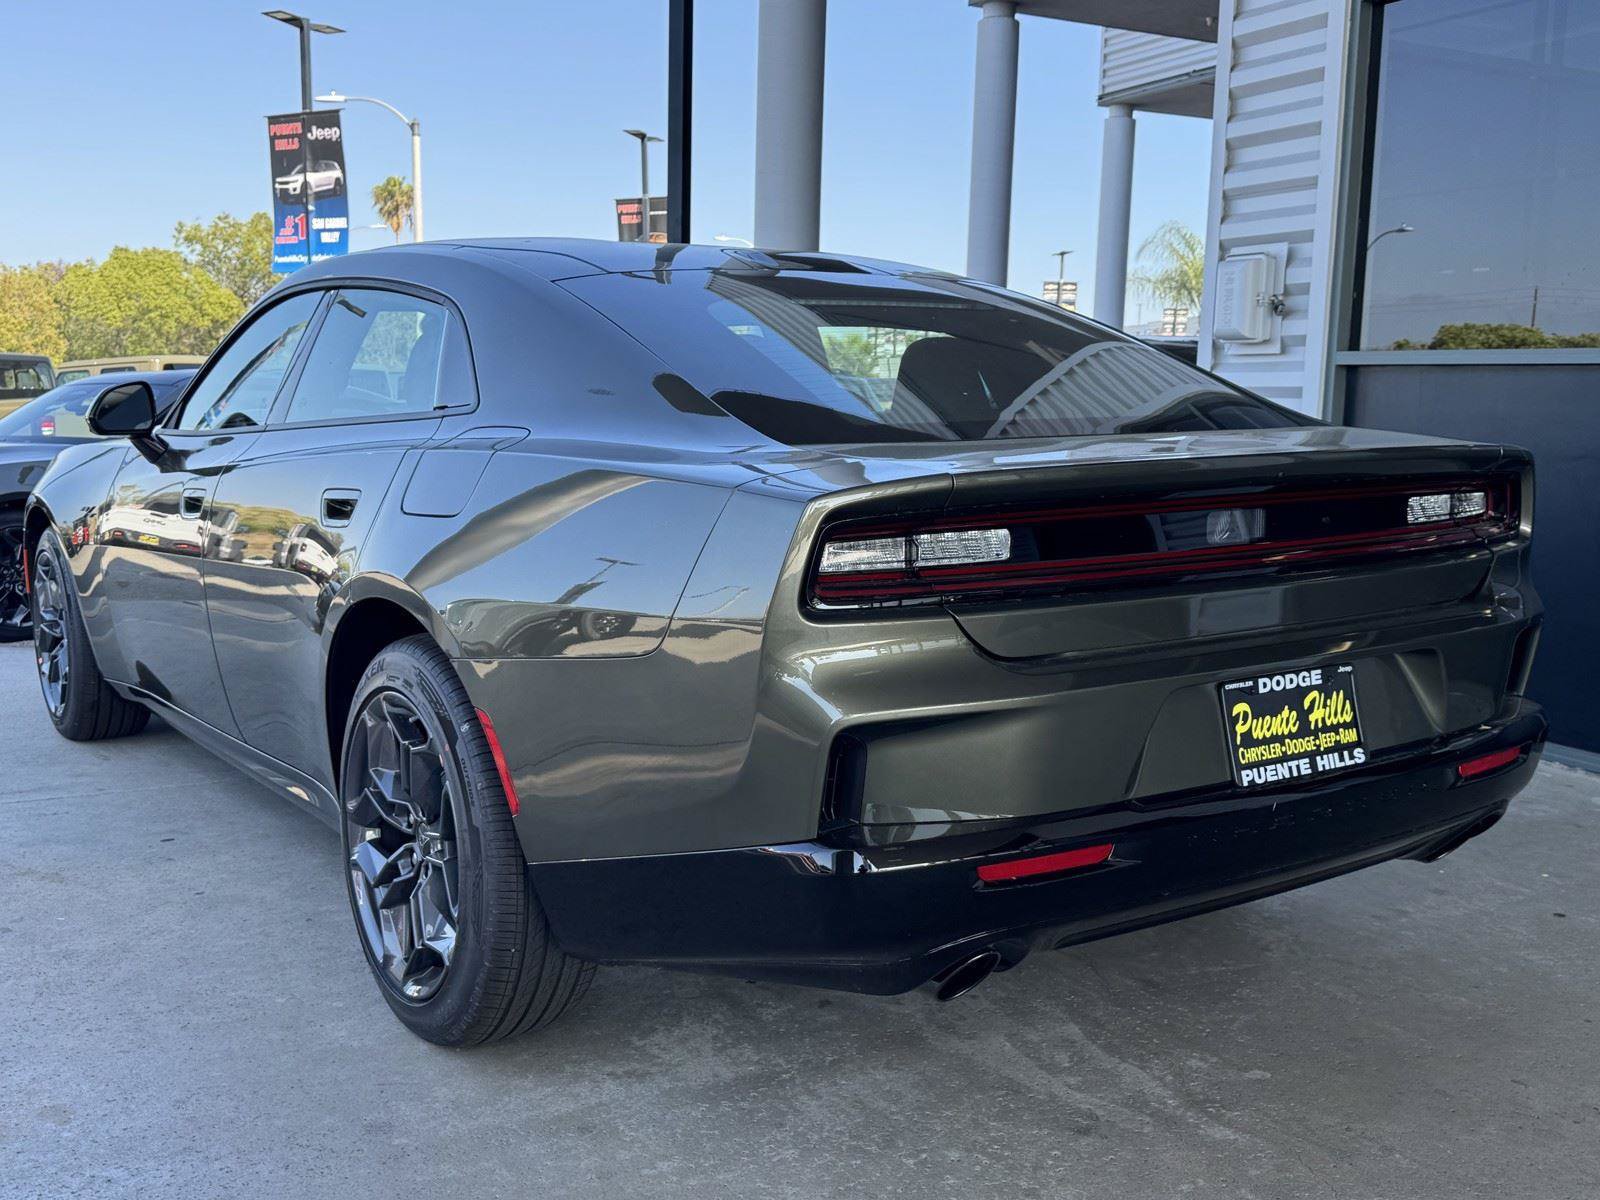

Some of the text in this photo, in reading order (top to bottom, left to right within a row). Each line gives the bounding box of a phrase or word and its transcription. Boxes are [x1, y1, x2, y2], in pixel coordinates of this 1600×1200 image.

[307, 125, 340, 142] Jeep
[1224, 665, 1353, 694] CHRYSLER DODGE Jeep
[1232, 689, 1354, 745] Puente Hills
[1240, 747, 1366, 787] PUENTE HILLS
